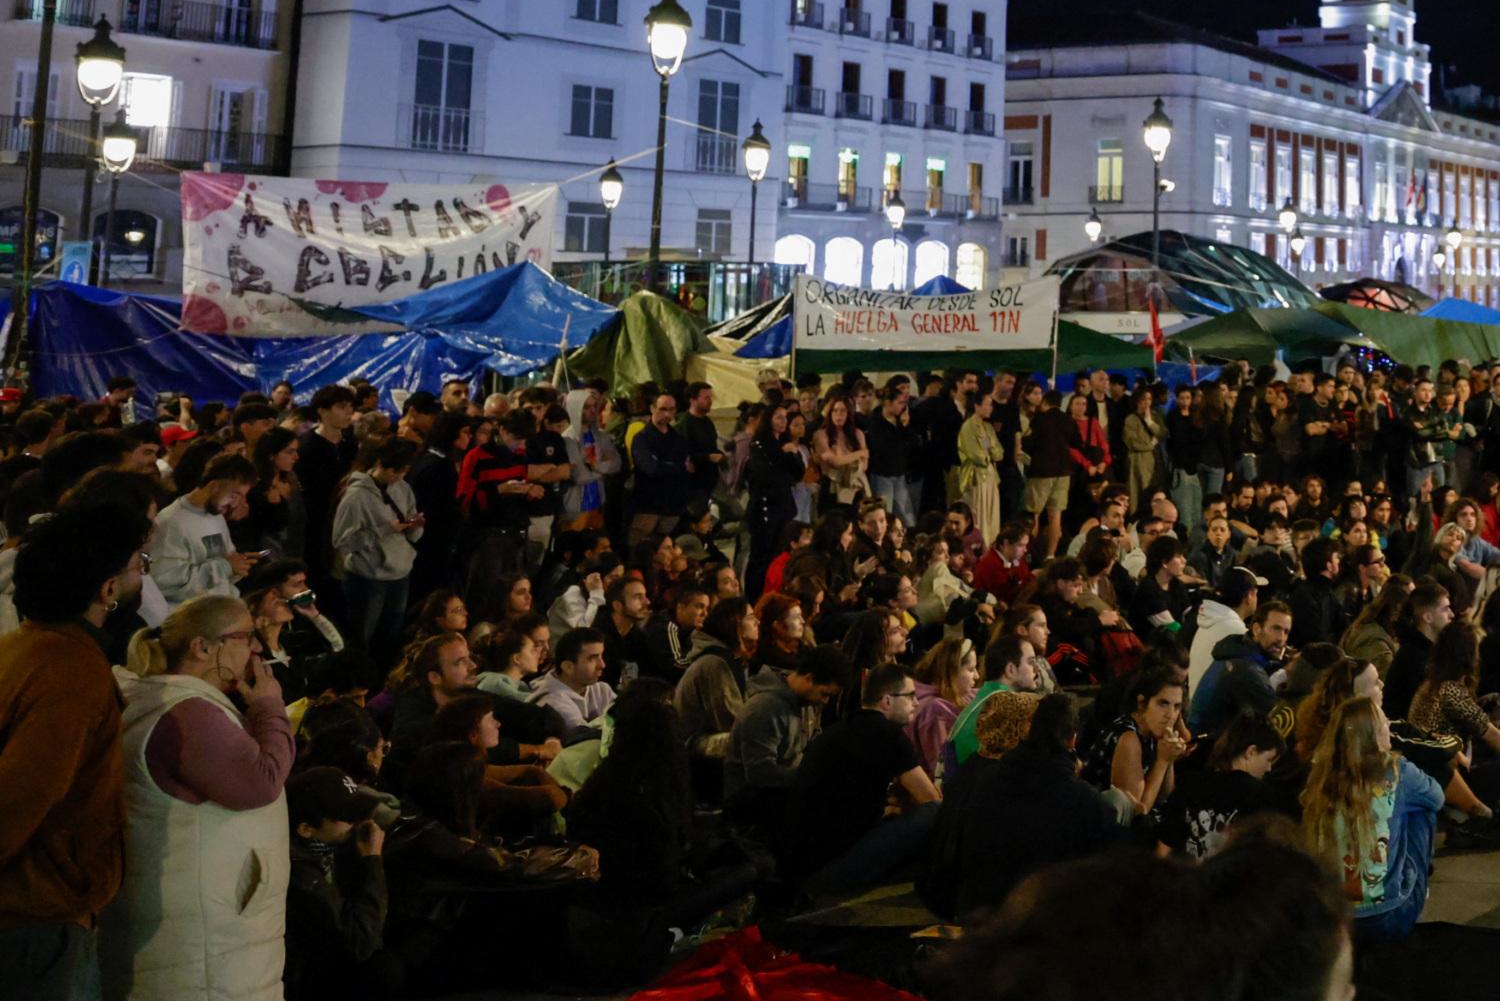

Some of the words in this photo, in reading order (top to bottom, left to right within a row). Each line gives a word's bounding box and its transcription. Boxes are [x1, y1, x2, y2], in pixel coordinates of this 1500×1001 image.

[517, 205, 542, 240] Y
[928, 294, 977, 311] DESDE
[990, 285, 1024, 309] SOL
[805, 314, 826, 337] LA
[834, 310, 898, 336] HUELGA
[911, 311, 980, 335] GENERAL
[989, 310, 1021, 335] 11N
[1117, 319, 1141, 328] SOL
